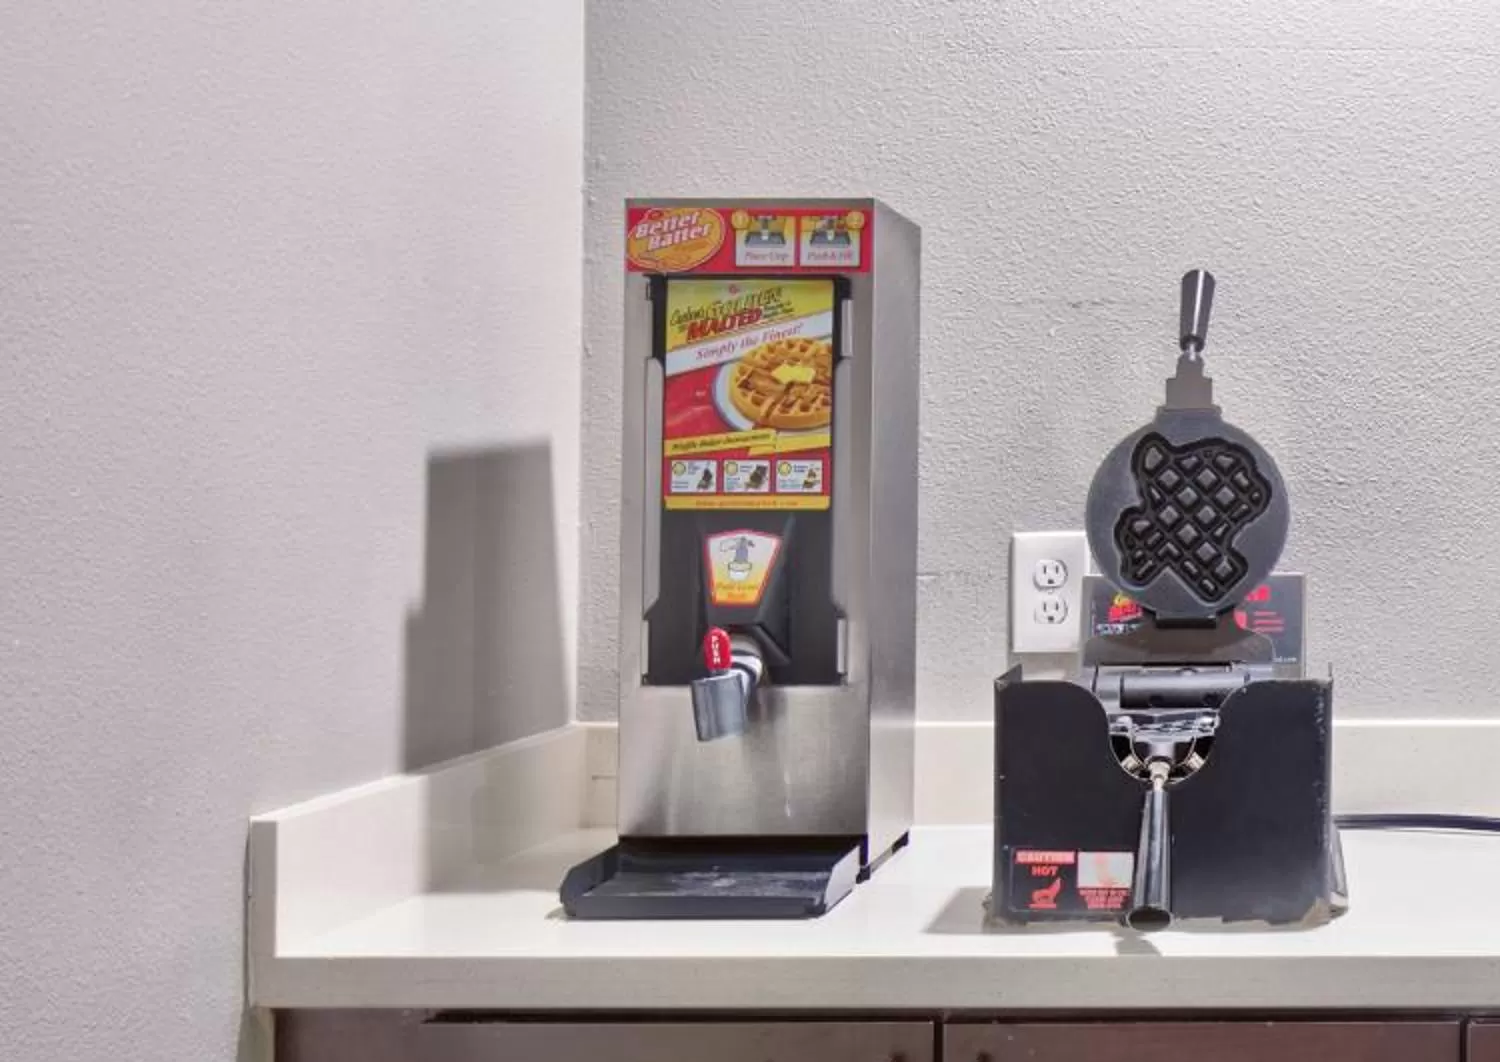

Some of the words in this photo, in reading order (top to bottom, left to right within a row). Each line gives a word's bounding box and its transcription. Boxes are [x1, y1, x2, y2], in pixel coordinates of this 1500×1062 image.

[636, 212, 700, 238] Better
[648, 223, 712, 251] Batter
[686, 308, 763, 341] MALTED
[695, 339, 738, 361] Simply
[740, 334, 758, 349] the
[1032, 865, 1059, 876] HOT
